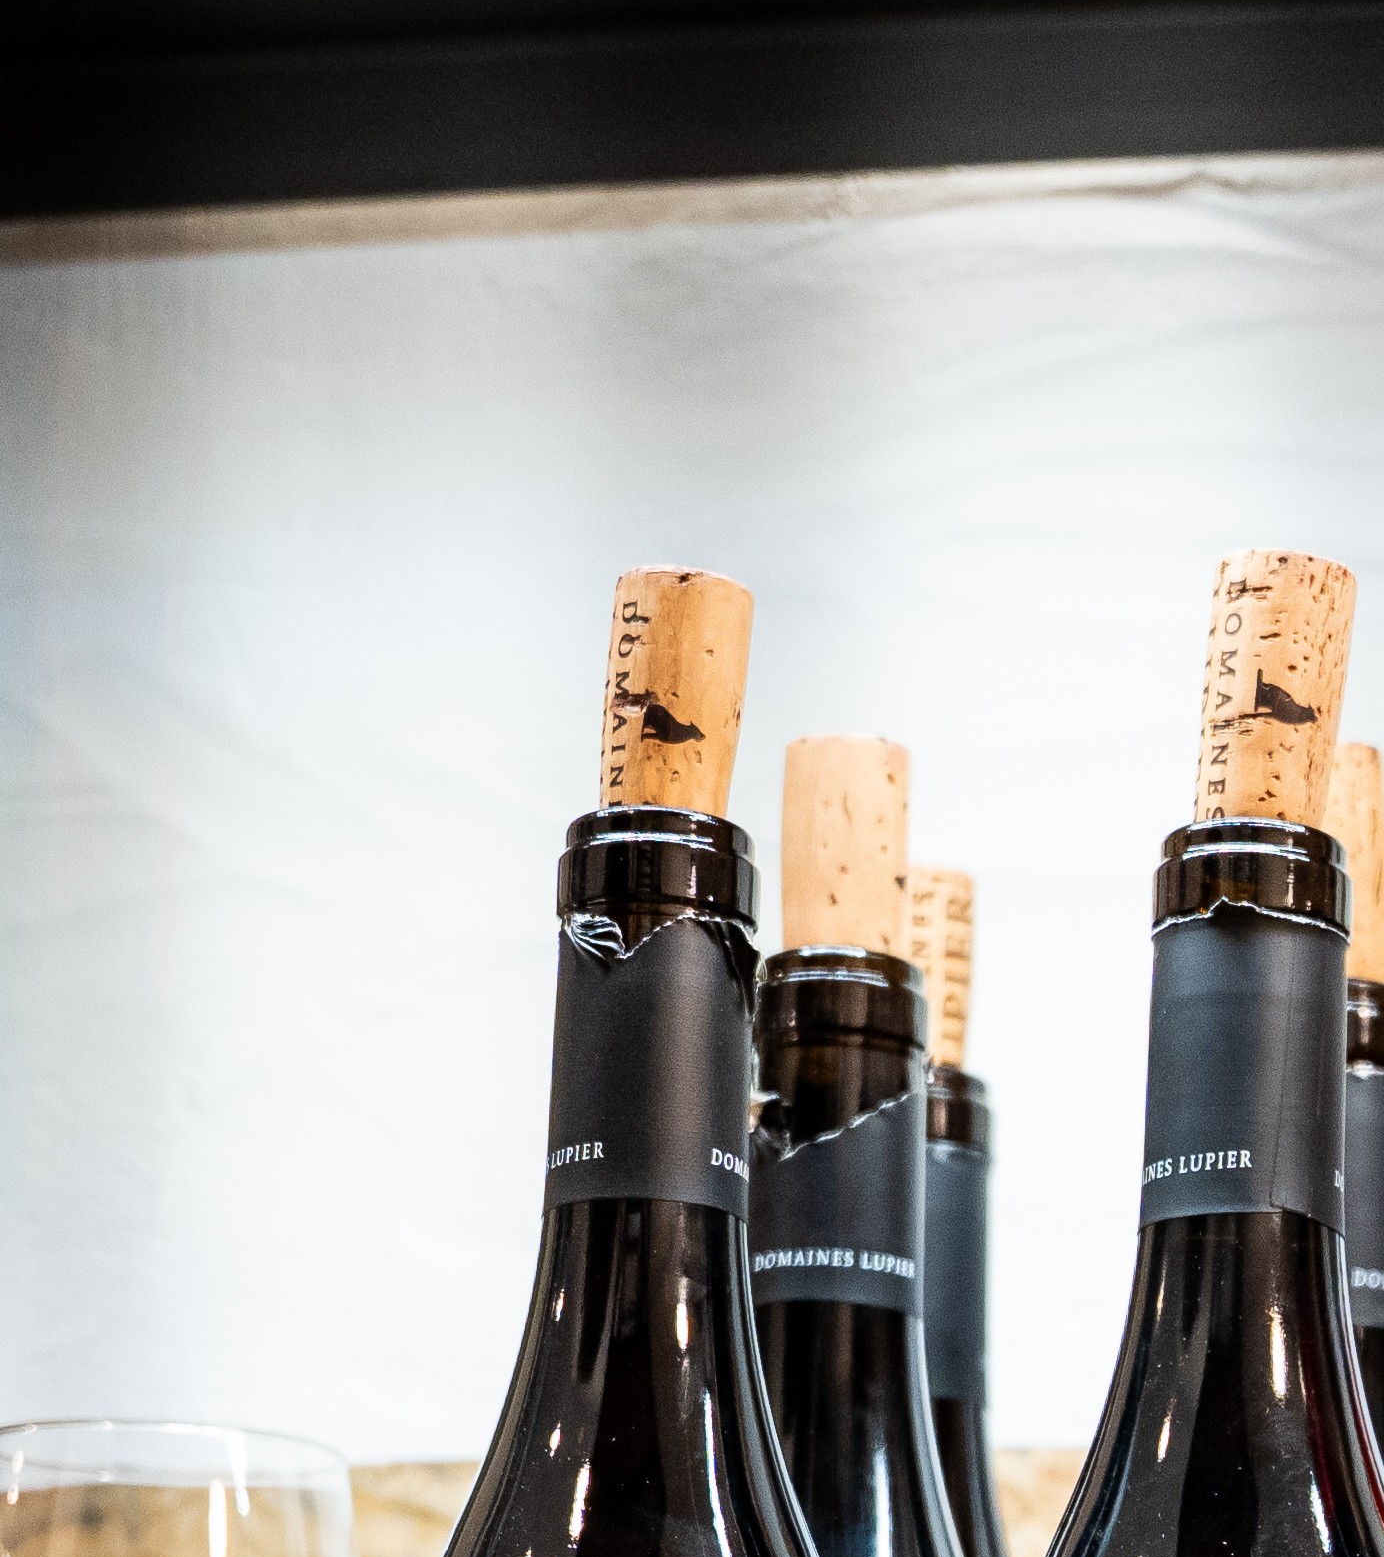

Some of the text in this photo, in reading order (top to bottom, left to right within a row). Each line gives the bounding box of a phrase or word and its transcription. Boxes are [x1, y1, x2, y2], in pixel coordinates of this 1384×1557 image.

[550, 1141, 605, 1170] LUPIER
[1178, 1149, 1253, 1174] LUPIER
[752, 1247, 916, 1279] DOMAINES LUPIER
